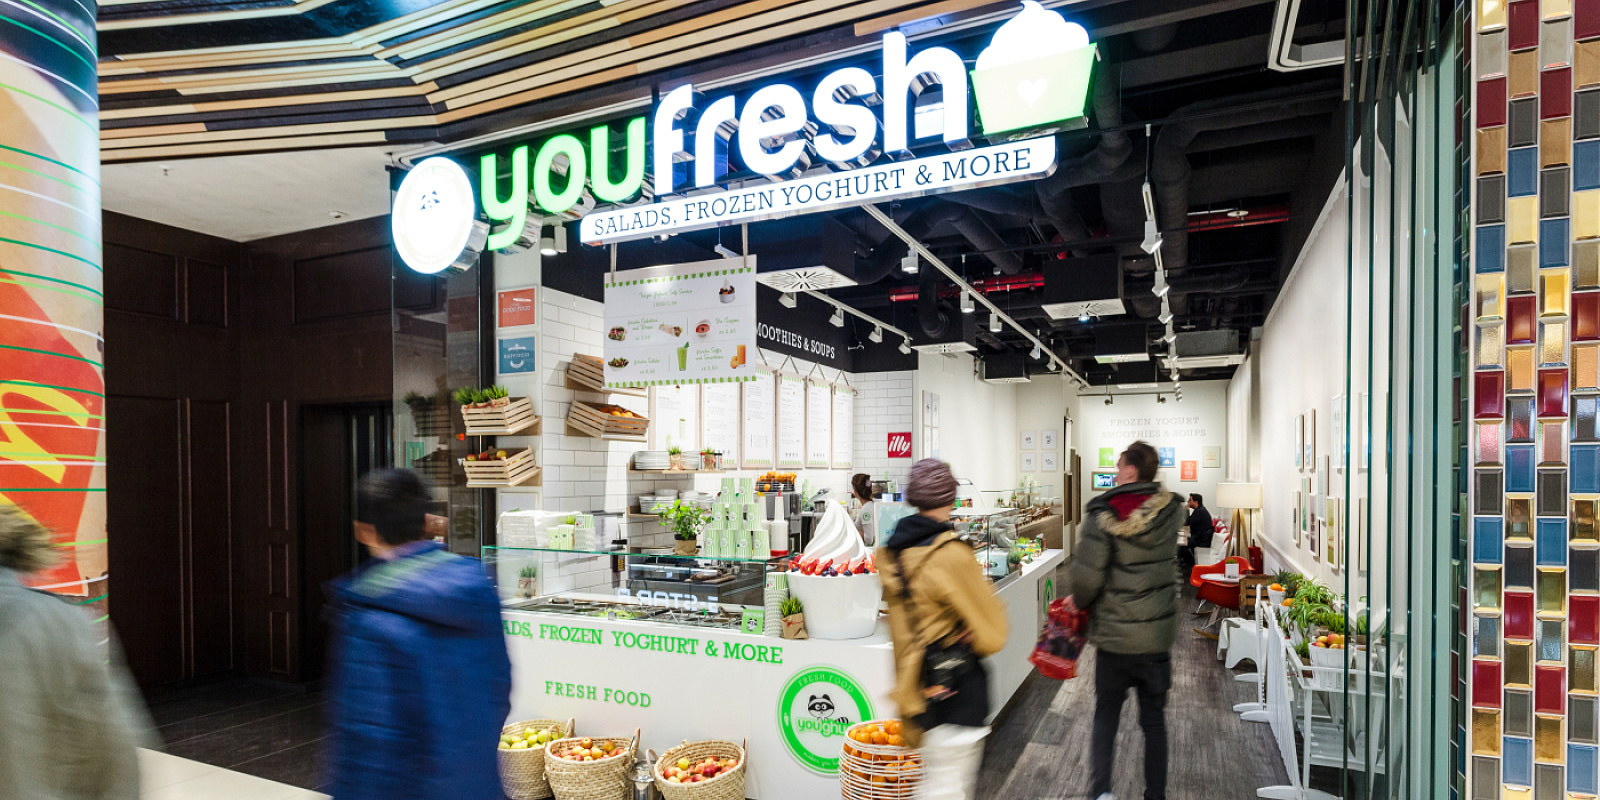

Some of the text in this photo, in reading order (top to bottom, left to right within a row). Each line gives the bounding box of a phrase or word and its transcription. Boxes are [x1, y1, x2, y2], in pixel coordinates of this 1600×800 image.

[594, 148, 1031, 236] SALADS, FROZEN YOGHURT & MORE
[803, 337, 810, 351] &
[810, 339, 835, 359] SOUPS
[1110, 417, 1200, 427] FROZEN YOGURT
[1101, 430, 1161, 438] SMOOTHIES
[1173, 429, 1207, 437] SOUPS
[888, 435, 911, 456] illy
[502, 620, 783, 664] ADS, FROZEN YOGHURT & MORE
[798, 673, 854, 693] FRESH FOOD
[545, 680, 651, 708] FRESH FOOD
